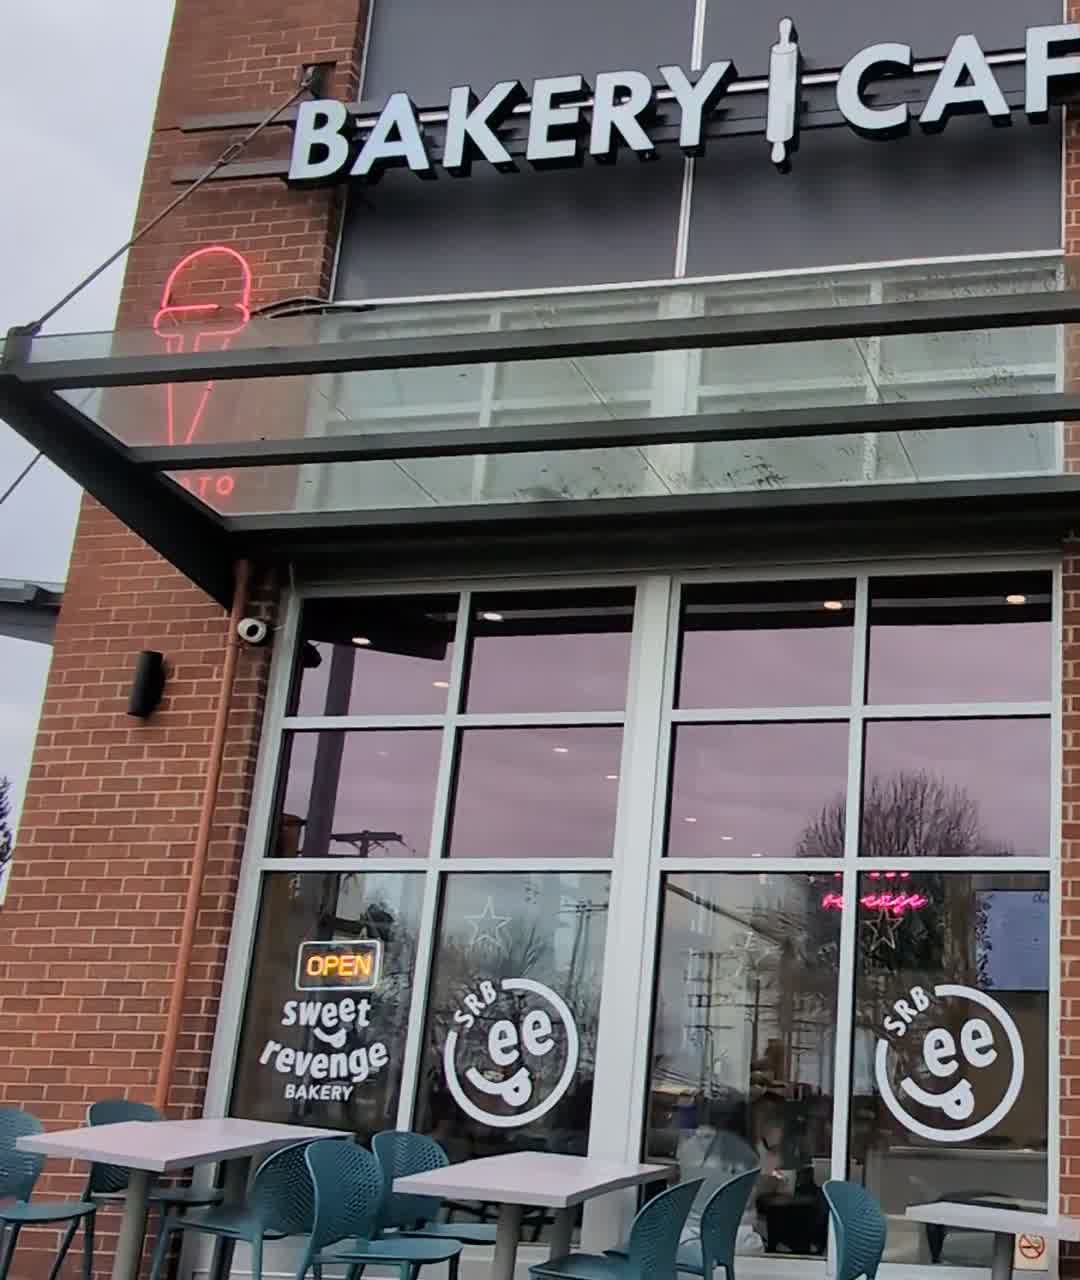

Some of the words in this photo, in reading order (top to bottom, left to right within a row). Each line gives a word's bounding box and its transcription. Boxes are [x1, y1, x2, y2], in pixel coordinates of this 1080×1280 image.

[287, 59, 736, 184] BAKERY
[305, 952, 373, 979] OPEN
[281, 996, 372, 1028] sweet
[453, 979, 498, 1030] SRB
[883, 985, 932, 1037] SRB
[259, 1038, 390, 1083] revenge
[284, 1083, 355, 1102] BAKERY
